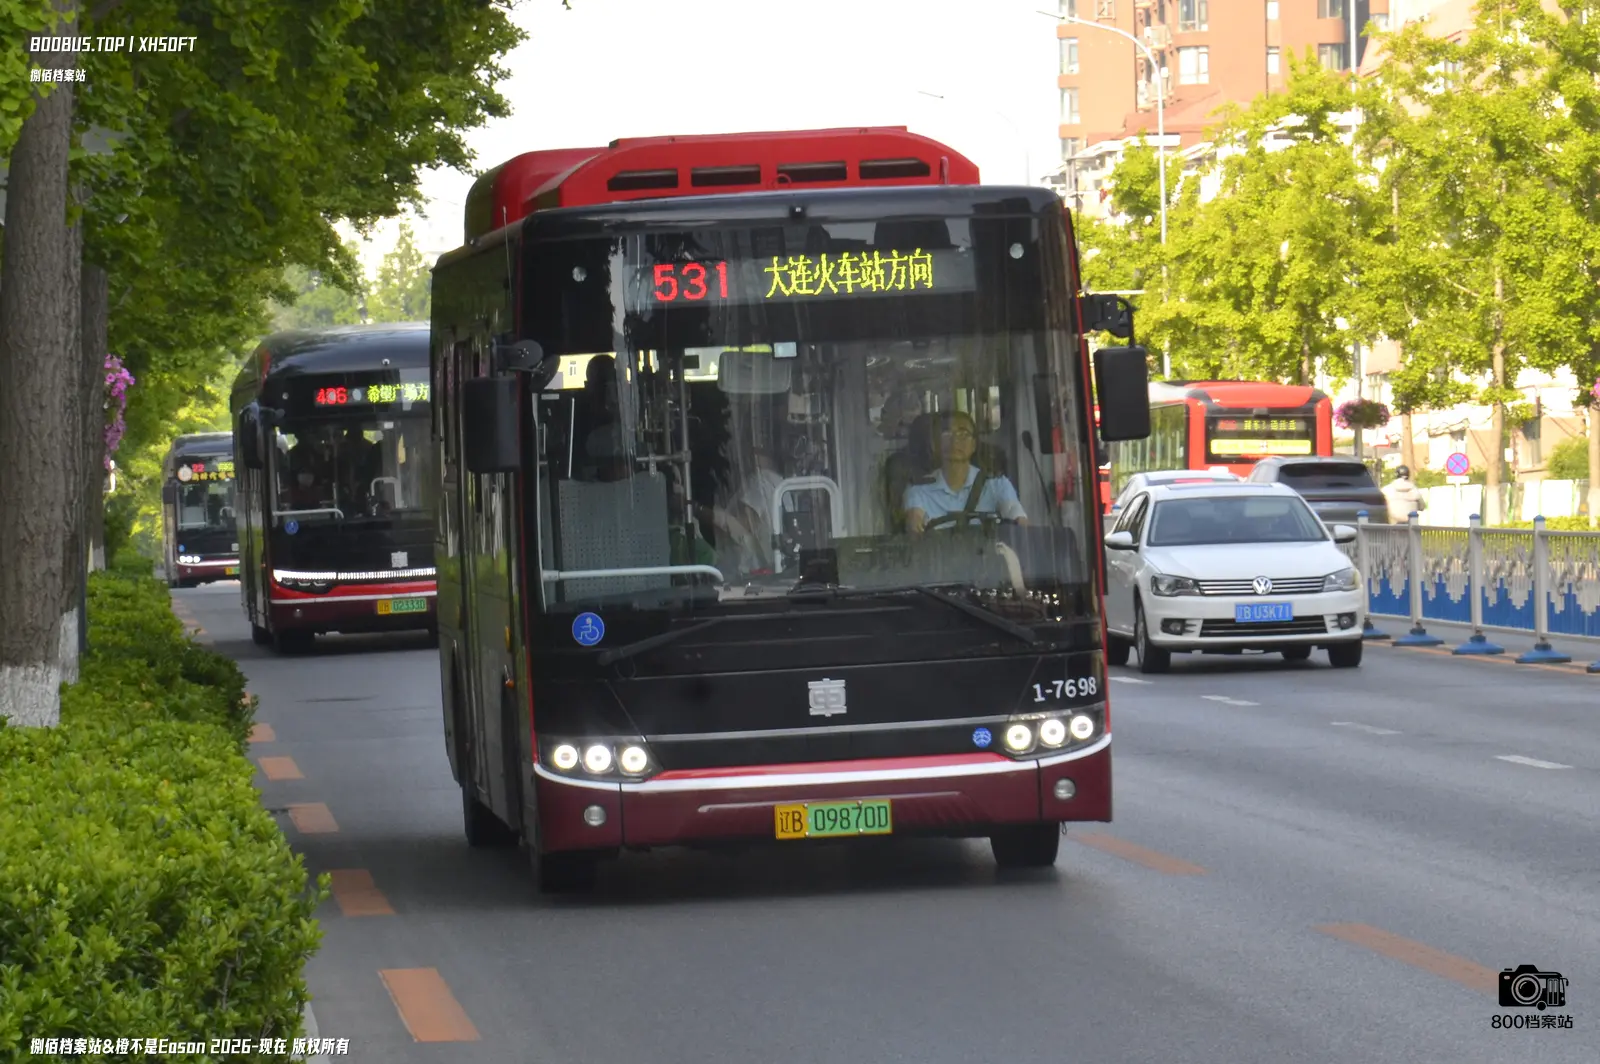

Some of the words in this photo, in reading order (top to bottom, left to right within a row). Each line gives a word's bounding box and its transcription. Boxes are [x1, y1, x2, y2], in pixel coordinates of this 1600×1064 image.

[653, 261, 729, 303] 531
[764, 247, 934, 299] 大连火车站方向
[1032, 676, 1097, 703] 1-7698
[779, 810, 804, 833] 辽B
